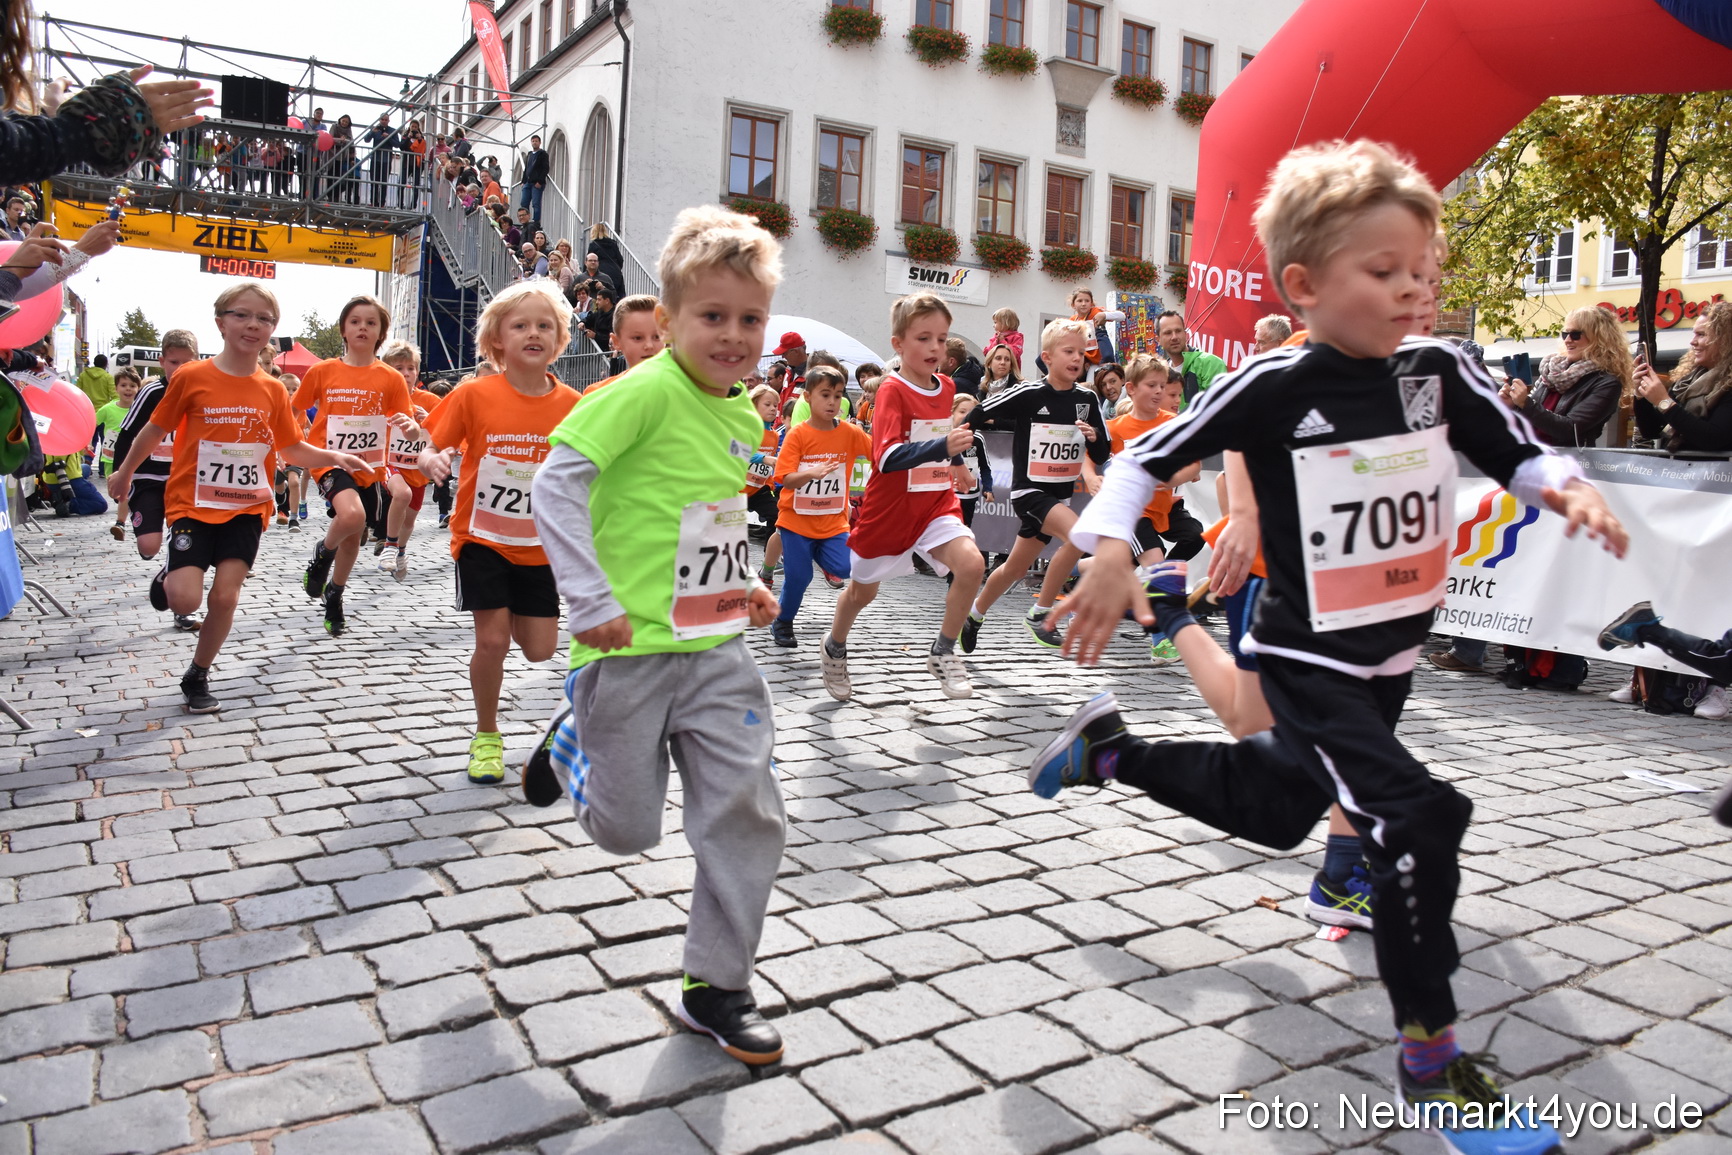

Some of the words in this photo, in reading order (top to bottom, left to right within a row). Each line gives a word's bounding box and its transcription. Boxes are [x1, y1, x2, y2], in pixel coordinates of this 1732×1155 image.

[193, 223, 268, 253] ZIEL
[908, 266, 950, 285] swn
[1189, 260, 1263, 302] STORE
[935, 285, 960, 293] neumarkt
[326, 387, 368, 395] Neumarkter
[326, 396, 359, 404] Stadtlauf
[203, 405, 258, 415] Neumarkter
[204, 416, 248, 425] Stadtlauf
[336, 432, 378, 450] 7232
[486, 433, 548, 443] Neumarkter
[1039, 441, 1080, 460] 7056
[1373, 450, 1428, 472] BOCK
[210, 462, 259, 486] 7135
[1625, 463, 1653, 476] Netze
[1660, 468, 1695, 480] Freizeit
[214, 489, 257, 500] Konstantin
[804, 478, 840, 495] 7174
[1331, 484, 1442, 555] 7091
[1385, 568, 1420, 589] Max
